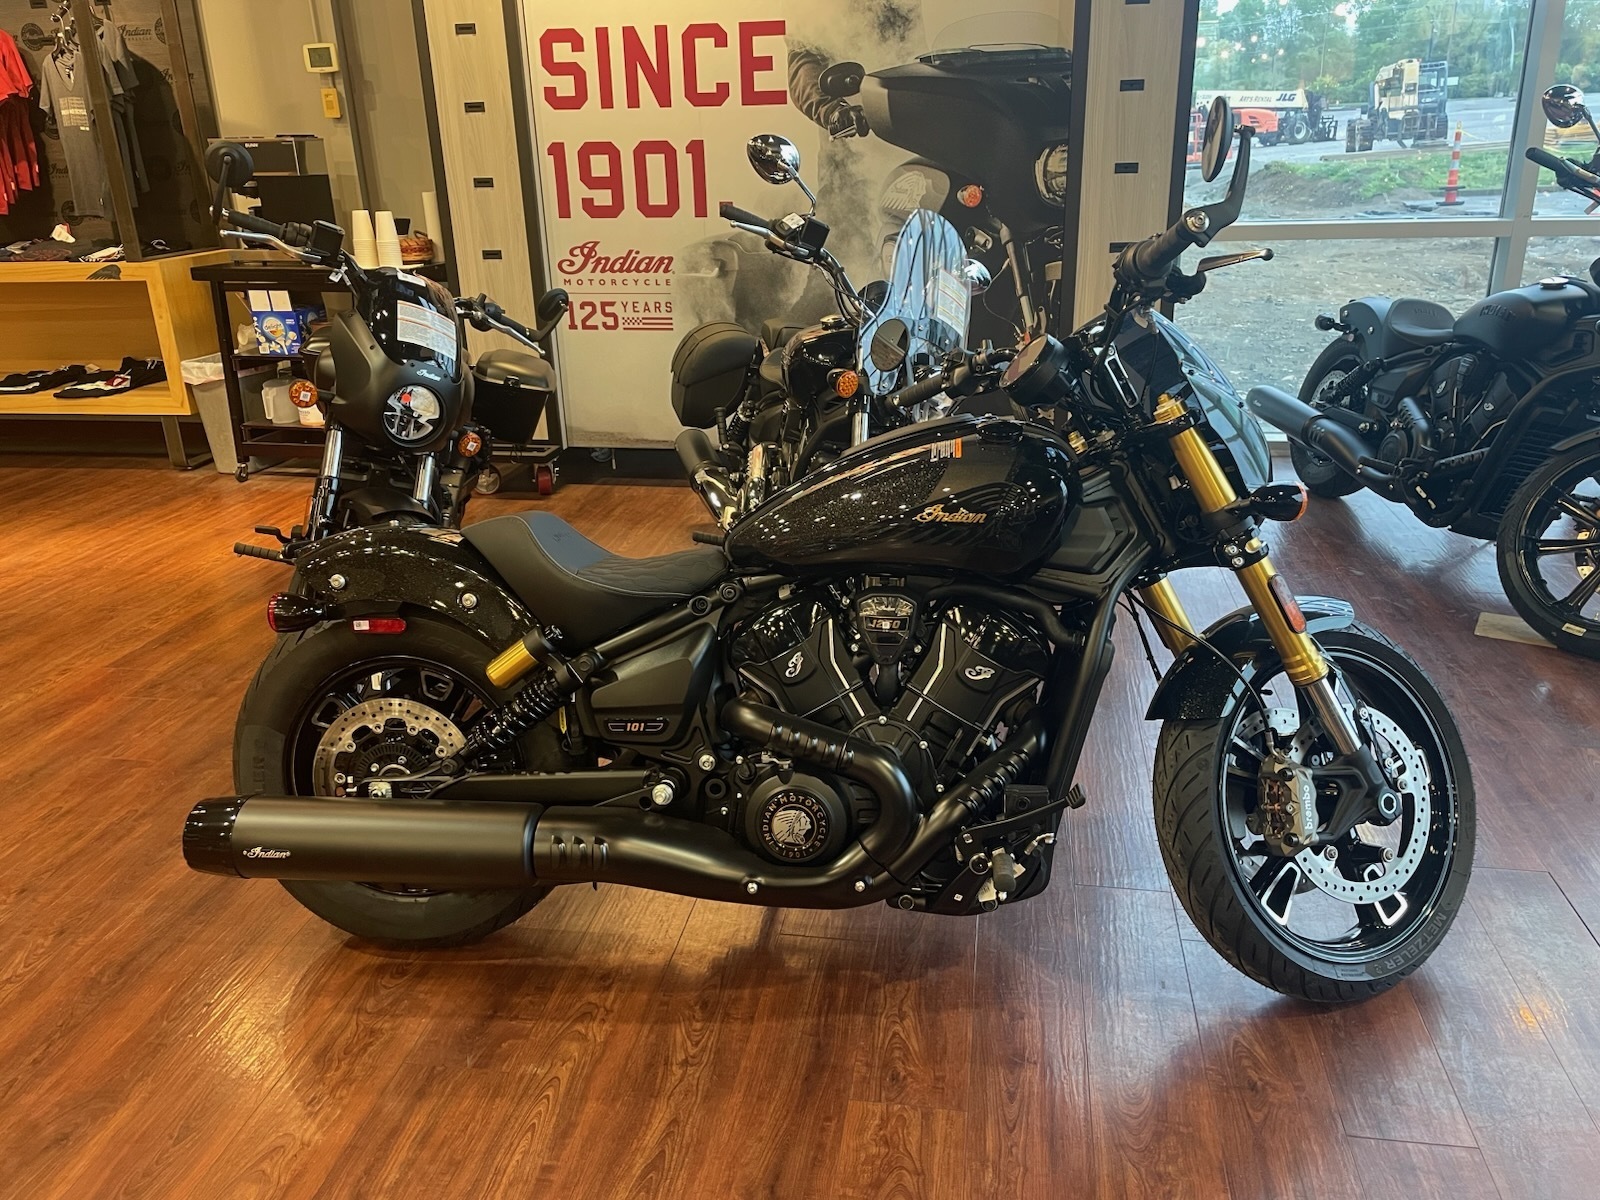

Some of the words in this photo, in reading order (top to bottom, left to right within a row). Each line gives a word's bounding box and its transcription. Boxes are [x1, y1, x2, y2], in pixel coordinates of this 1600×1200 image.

[539, 20, 788, 110] SINCE
[1276, 93, 1297, 102] JLG
[557, 240, 674, 275] Indian
[563, 278, 671, 286] MOTORCYCLE
[568, 301, 619, 330] 125
[621, 301, 673, 313] YEARS
[912, 504, 987, 523] Indian
[867, 619, 901, 629] 120
[626, 722, 645, 731] 101
[1303, 784, 1314, 830] brembo
[762, 803, 778, 845] INDIAN
[780, 795, 827, 847] MOTORCYCLE
[246, 846, 287, 859] Indian
[1384, 912, 1447, 970] METZELER
